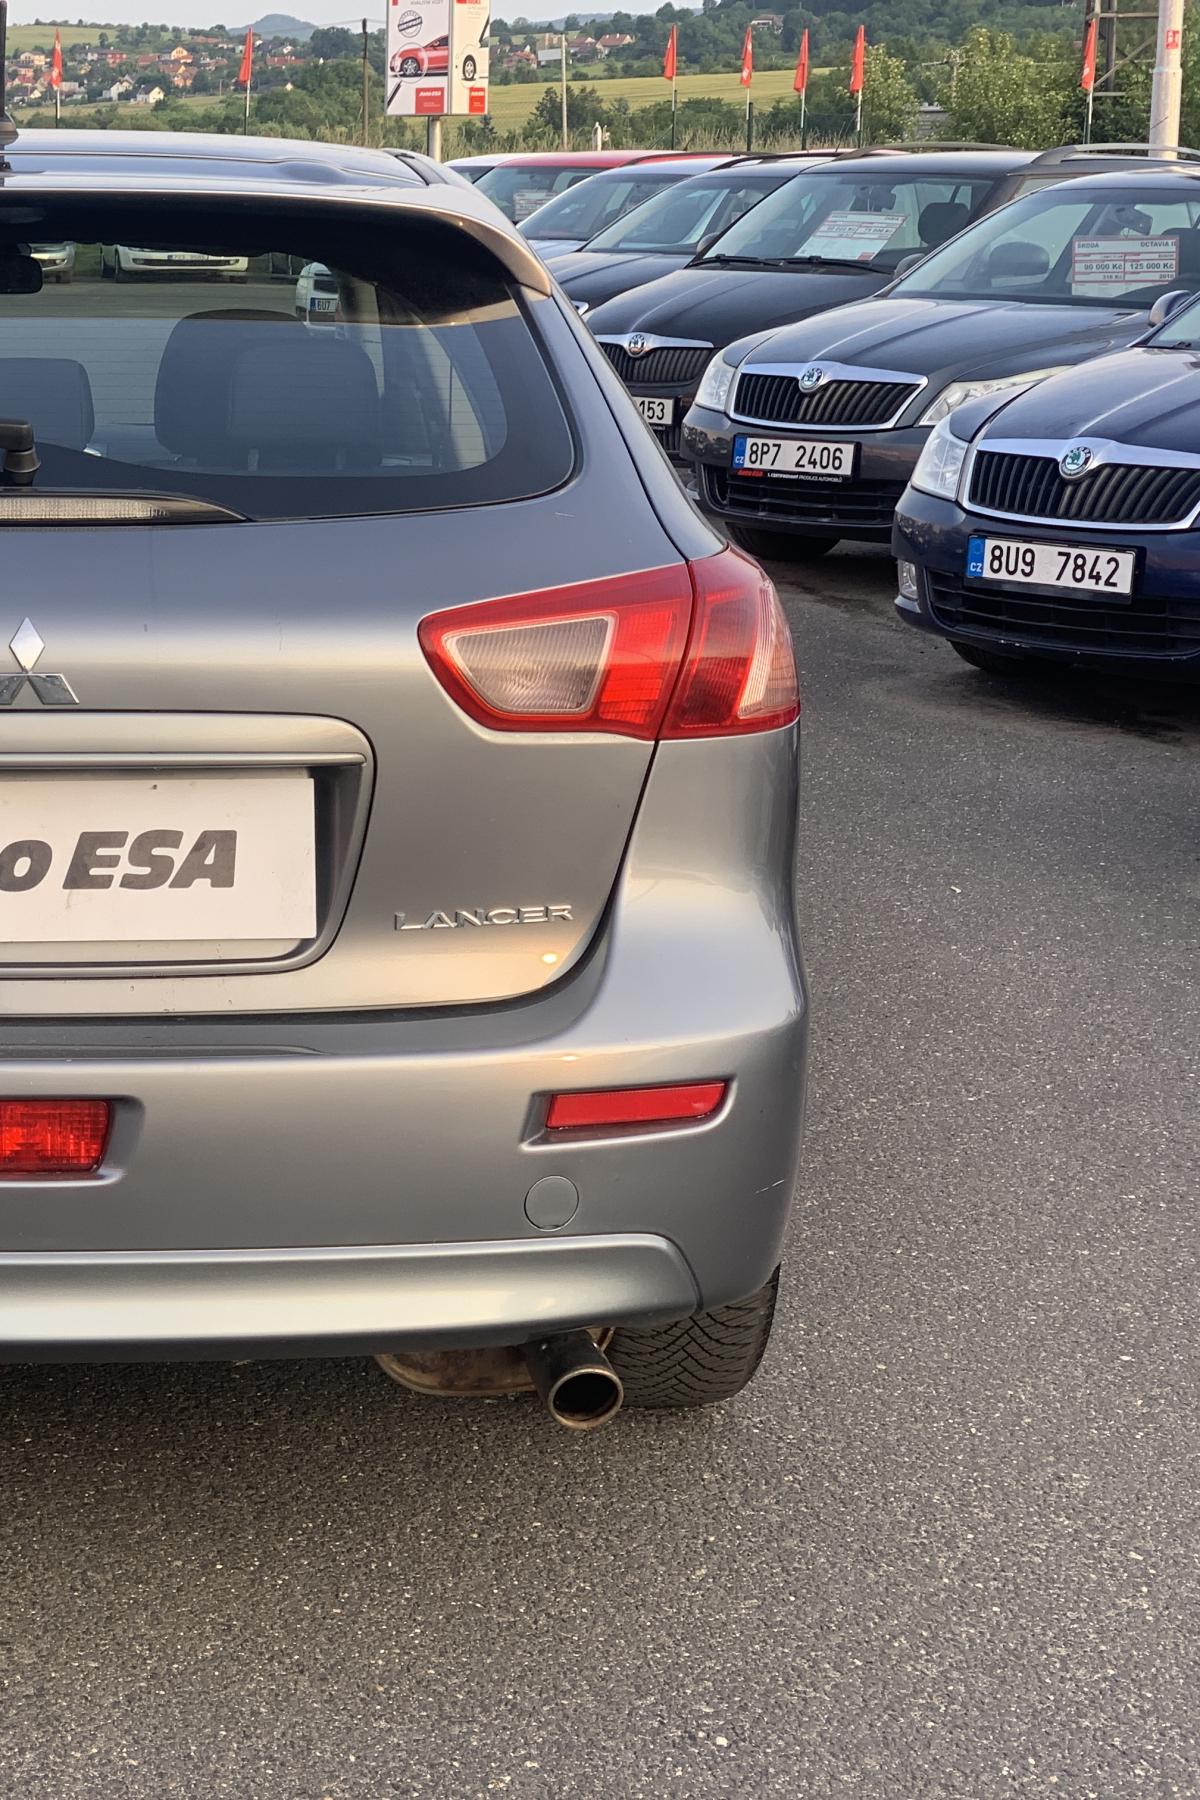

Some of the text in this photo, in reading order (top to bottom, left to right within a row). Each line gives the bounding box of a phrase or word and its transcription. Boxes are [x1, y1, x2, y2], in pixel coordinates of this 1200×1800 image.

[1146, 262, 1161, 270] 000
[1162, 262, 1174, 270] Kč
[639, 400, 665, 421] 153
[735, 456, 744, 464] CZ
[749, 442, 843, 471] 8P7 2406
[969, 562, 982, 573] CZ
[989, 544, 1120, 588] 8U9 7842
[61, 829, 238, 890] ESA
[394, 904, 574, 930] LANCER
